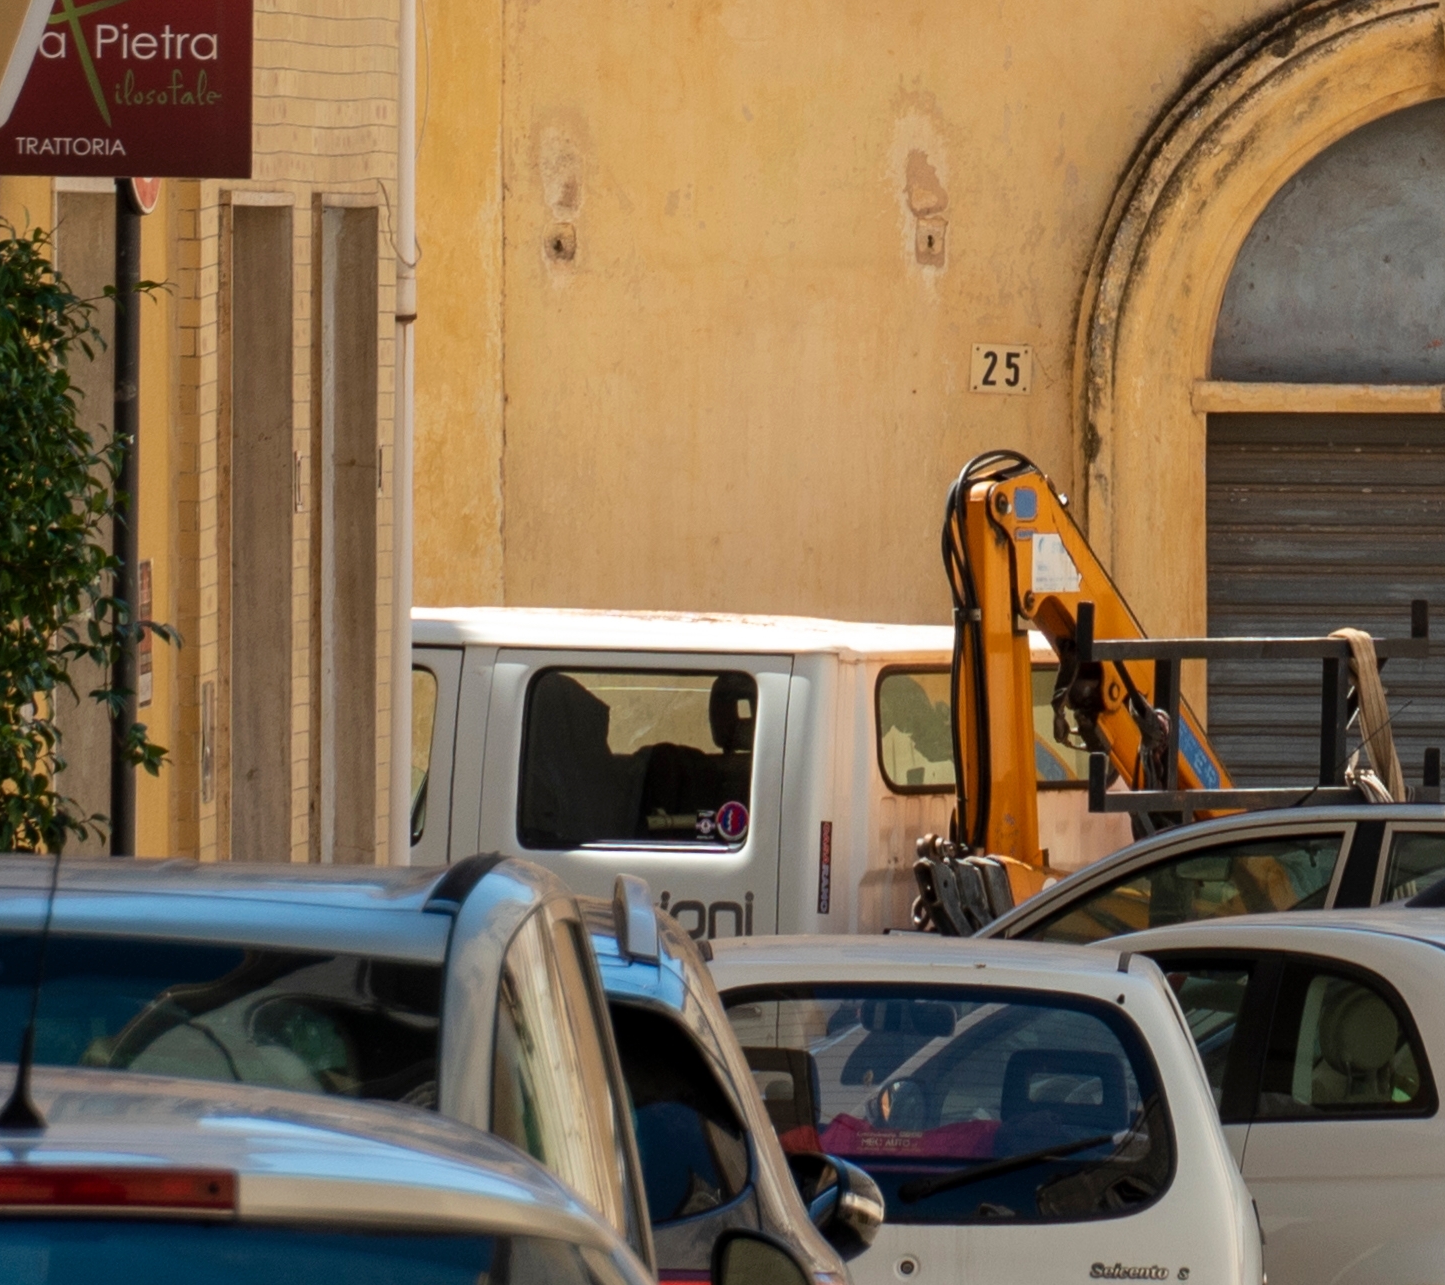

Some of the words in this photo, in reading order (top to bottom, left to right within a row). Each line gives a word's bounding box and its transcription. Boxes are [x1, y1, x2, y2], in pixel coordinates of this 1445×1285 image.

[96, 23, 219, 61] Pietra
[16, 137, 126, 156] TRATTORIA
[982, 351, 1020, 387] 25
[1089, 1262, 1169, 1279] Seicento
